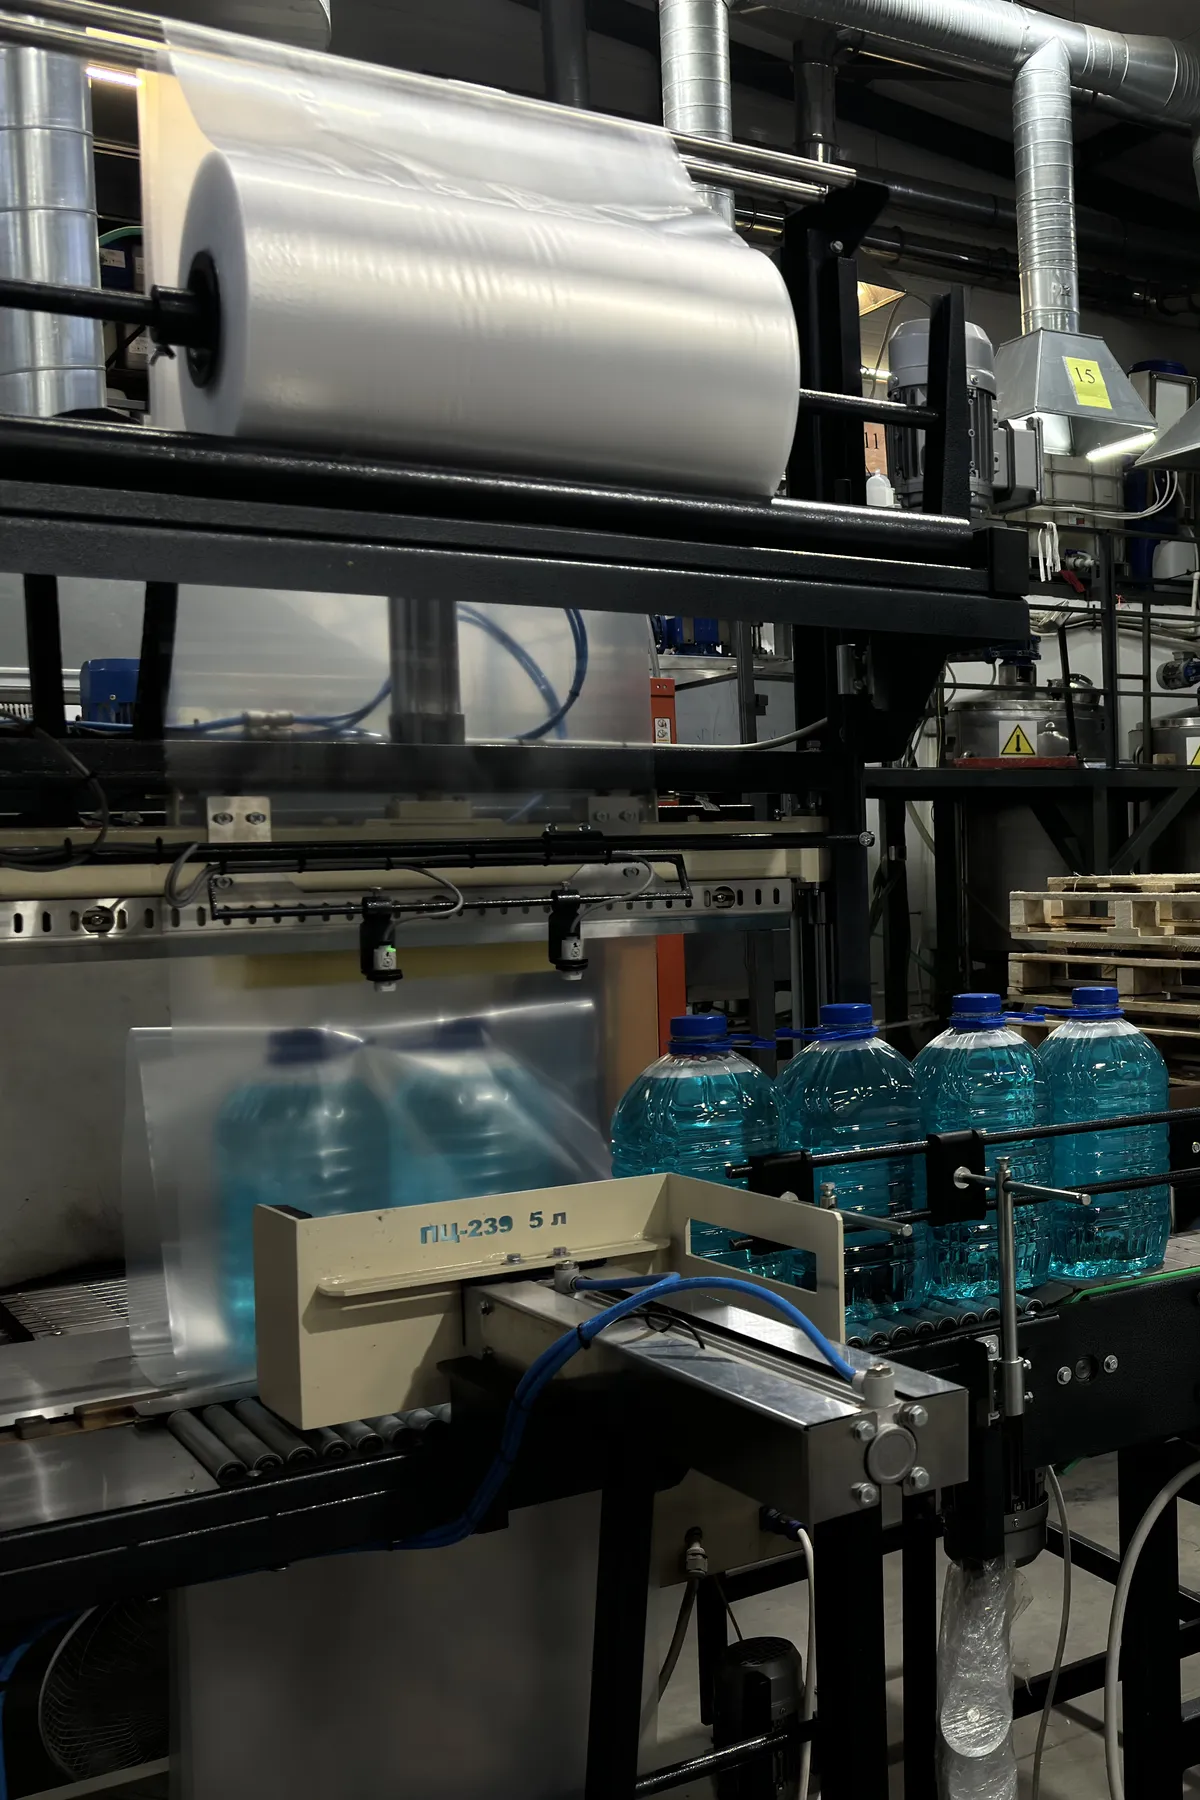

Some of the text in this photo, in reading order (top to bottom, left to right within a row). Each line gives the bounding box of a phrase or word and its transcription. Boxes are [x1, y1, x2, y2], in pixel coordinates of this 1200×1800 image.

[1075, 367, 1096, 384] 15
[420, 1215, 513, 1244] ПЦ-239
[529, 1211, 544, 1229] 5
